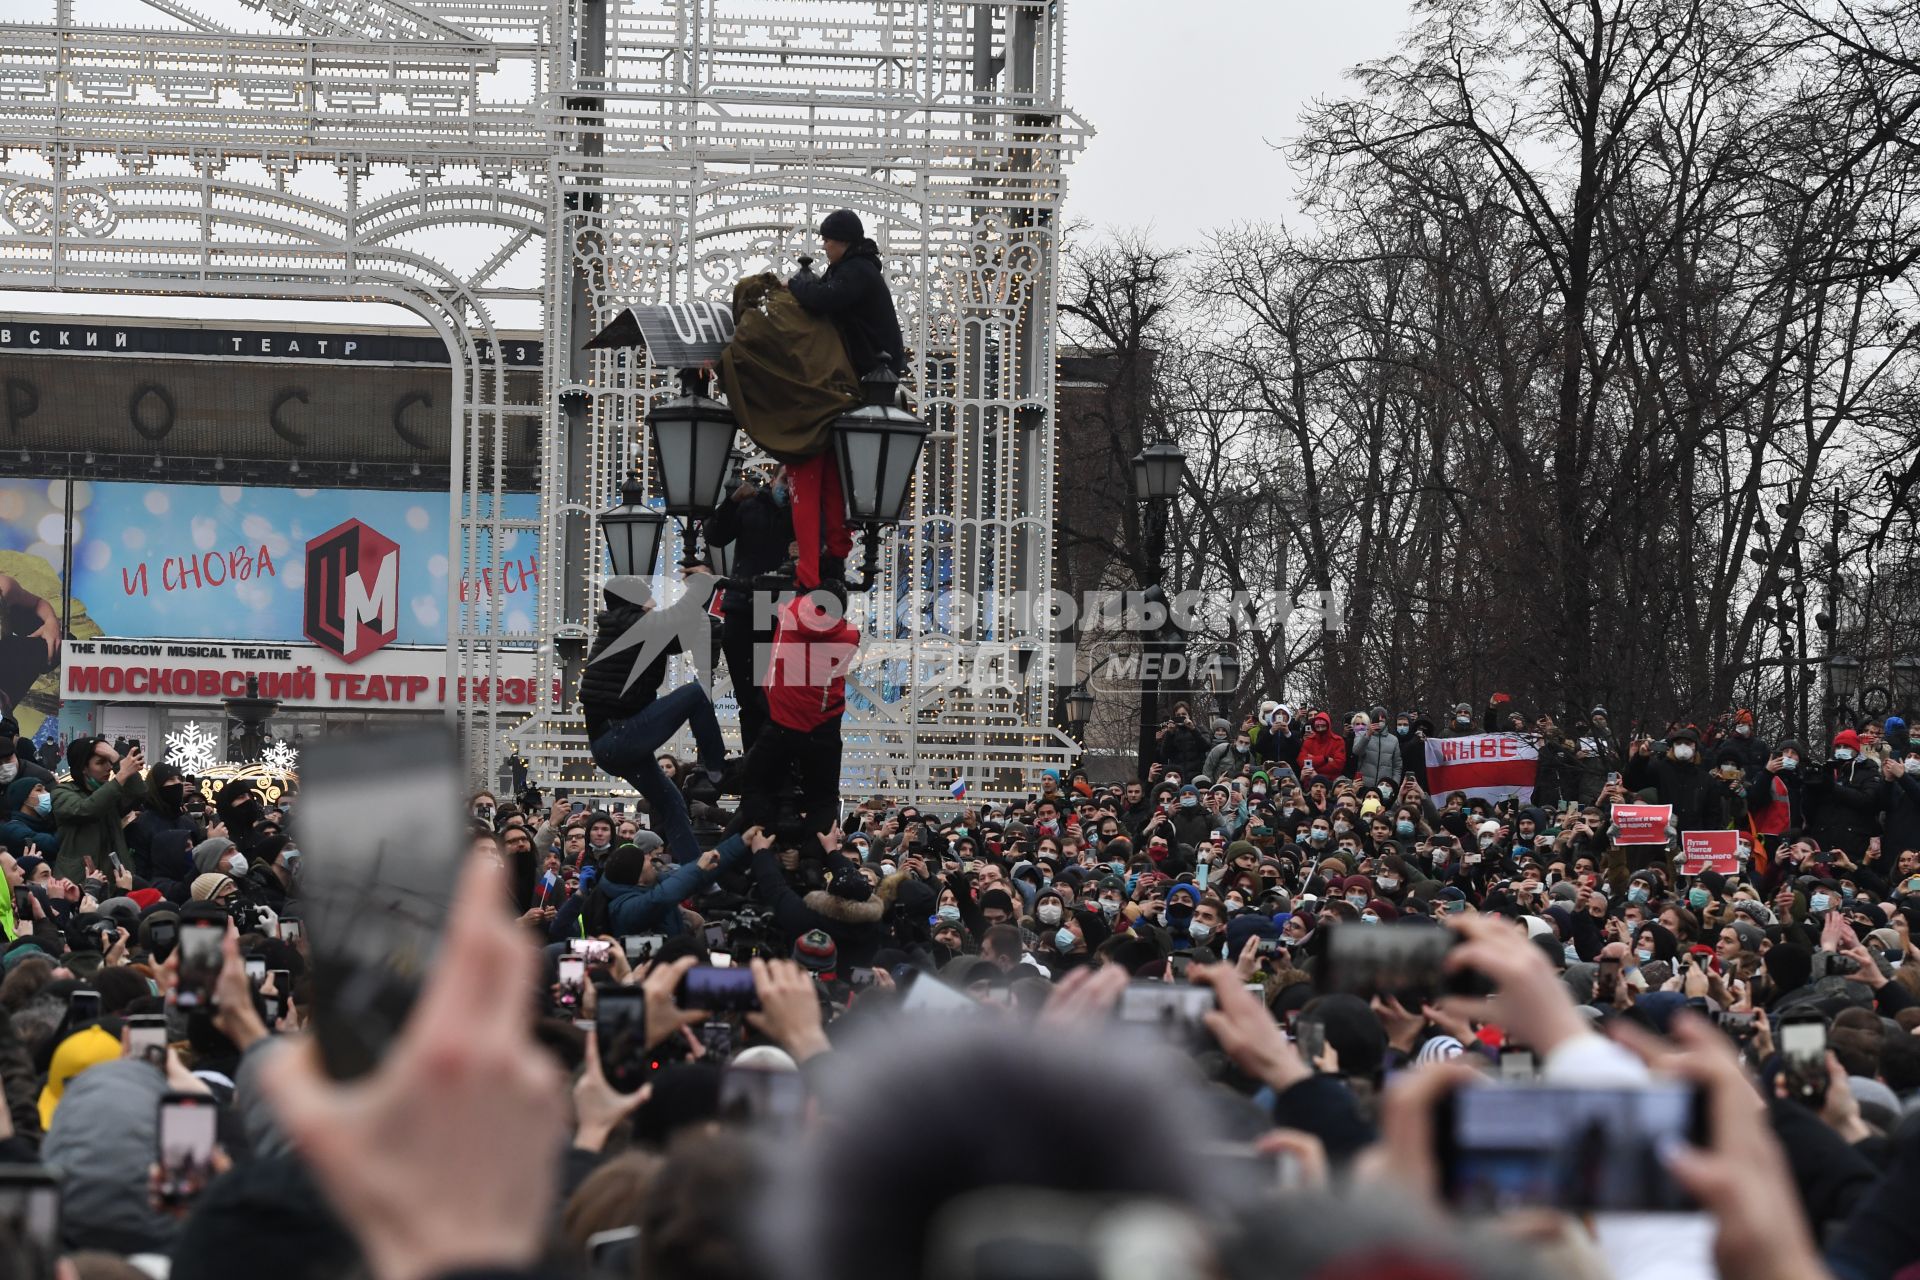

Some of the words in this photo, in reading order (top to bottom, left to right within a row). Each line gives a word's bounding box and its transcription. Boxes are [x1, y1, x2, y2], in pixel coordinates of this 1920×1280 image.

[232, 337, 357, 355] ТЕАТР
[122, 562, 148, 597] И
[162, 545, 276, 592] СНОВА
[70, 643, 95, 654] THE
[101, 644, 162, 656] MOSCOW
[168, 646, 227, 658] MUSICAL
[232, 648, 292, 660] THEATRE
[68, 665, 316, 699] МОСКОВСКИЙ
[325, 673, 429, 701] ТЕАТР
[1441, 738, 1518, 762] ЖЫВЕ
[1687, 839, 1708, 847] Путин
